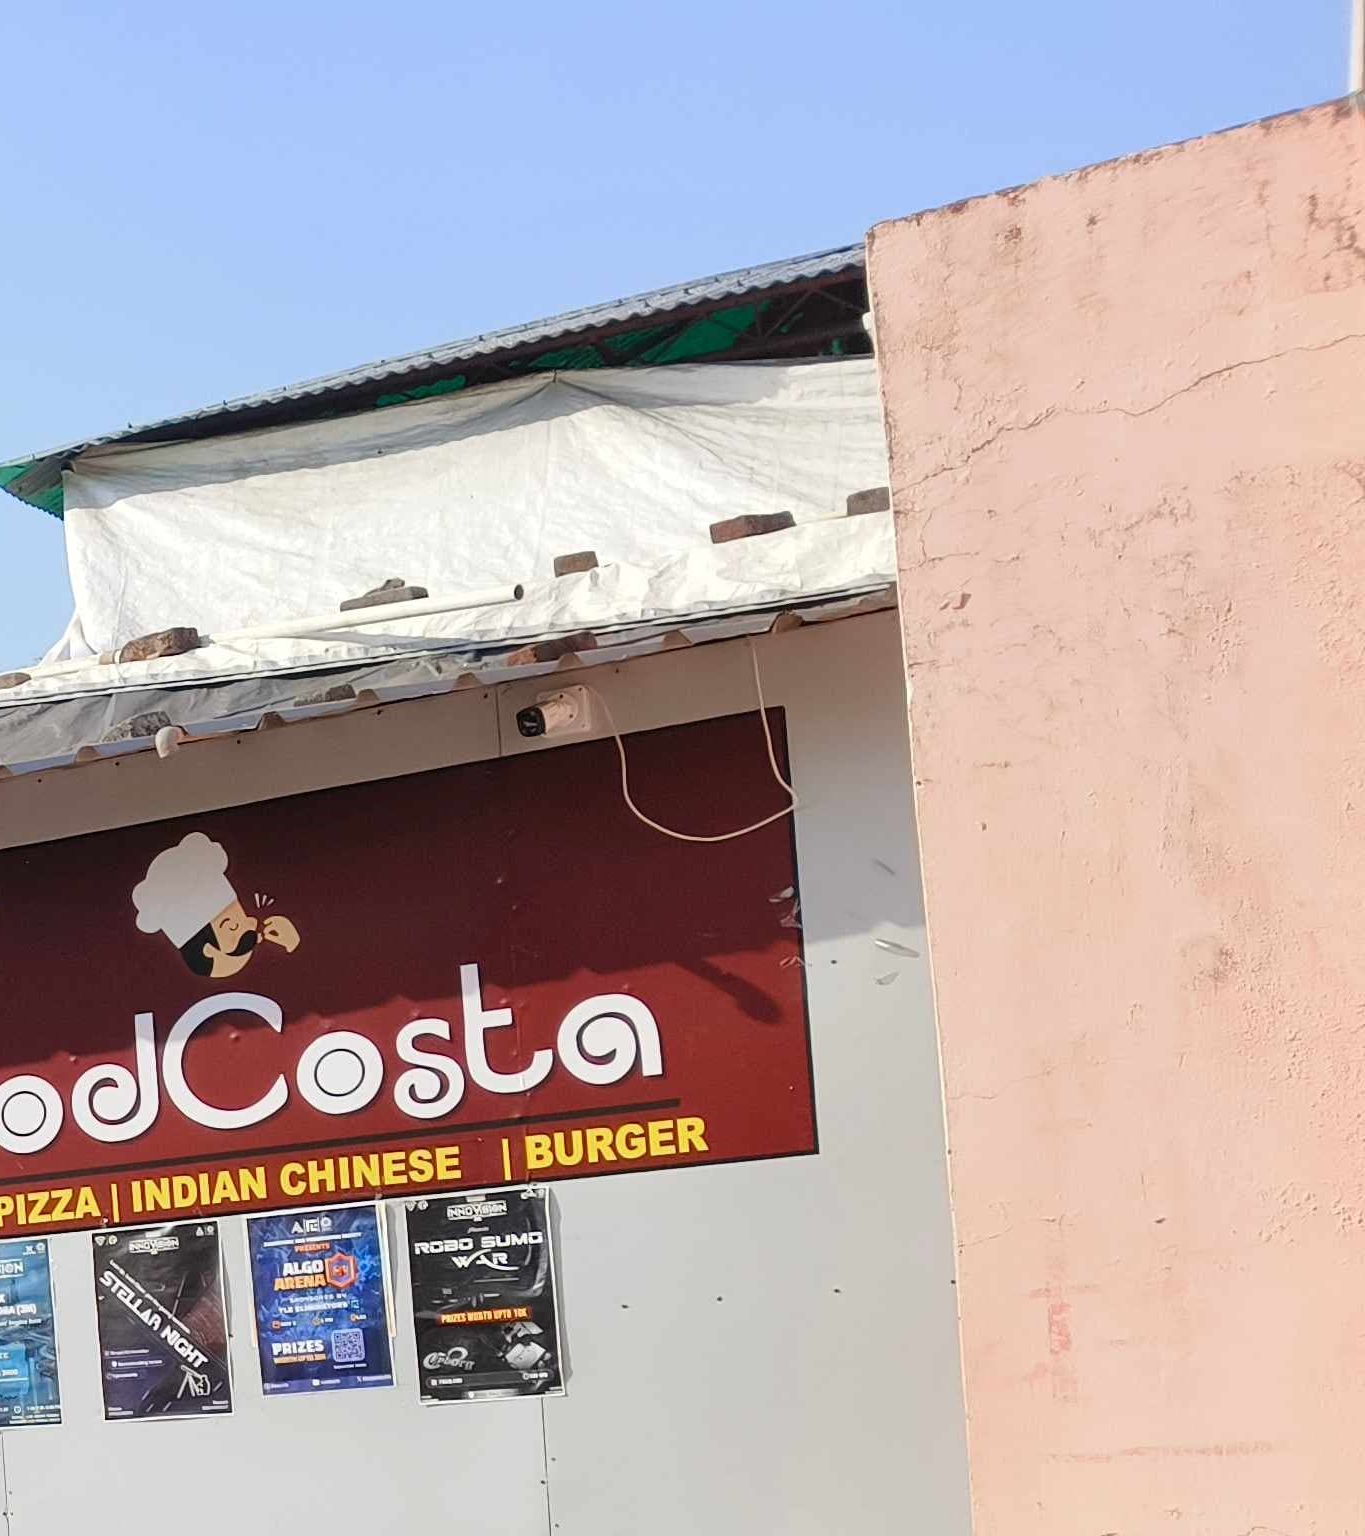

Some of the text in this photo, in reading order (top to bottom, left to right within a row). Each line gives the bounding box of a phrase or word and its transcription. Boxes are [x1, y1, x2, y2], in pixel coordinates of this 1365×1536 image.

[130, 1166, 268, 1214] INDIAN
[279, 1145, 462, 1197] CHINESE
[525, 1116, 709, 1170] BURGER
[414, 1231, 544, 1255] ROBO SUMO
[282, 1259, 324, 1276] ALGO
[451, 1250, 517, 1270] WAR
[274, 1273, 327, 1291] ARENA
[99, 1270, 162, 1331] STELLAR
[160, 1324, 209, 1368] NIGHT
[271, 1339, 324, 1356] PRIZES
